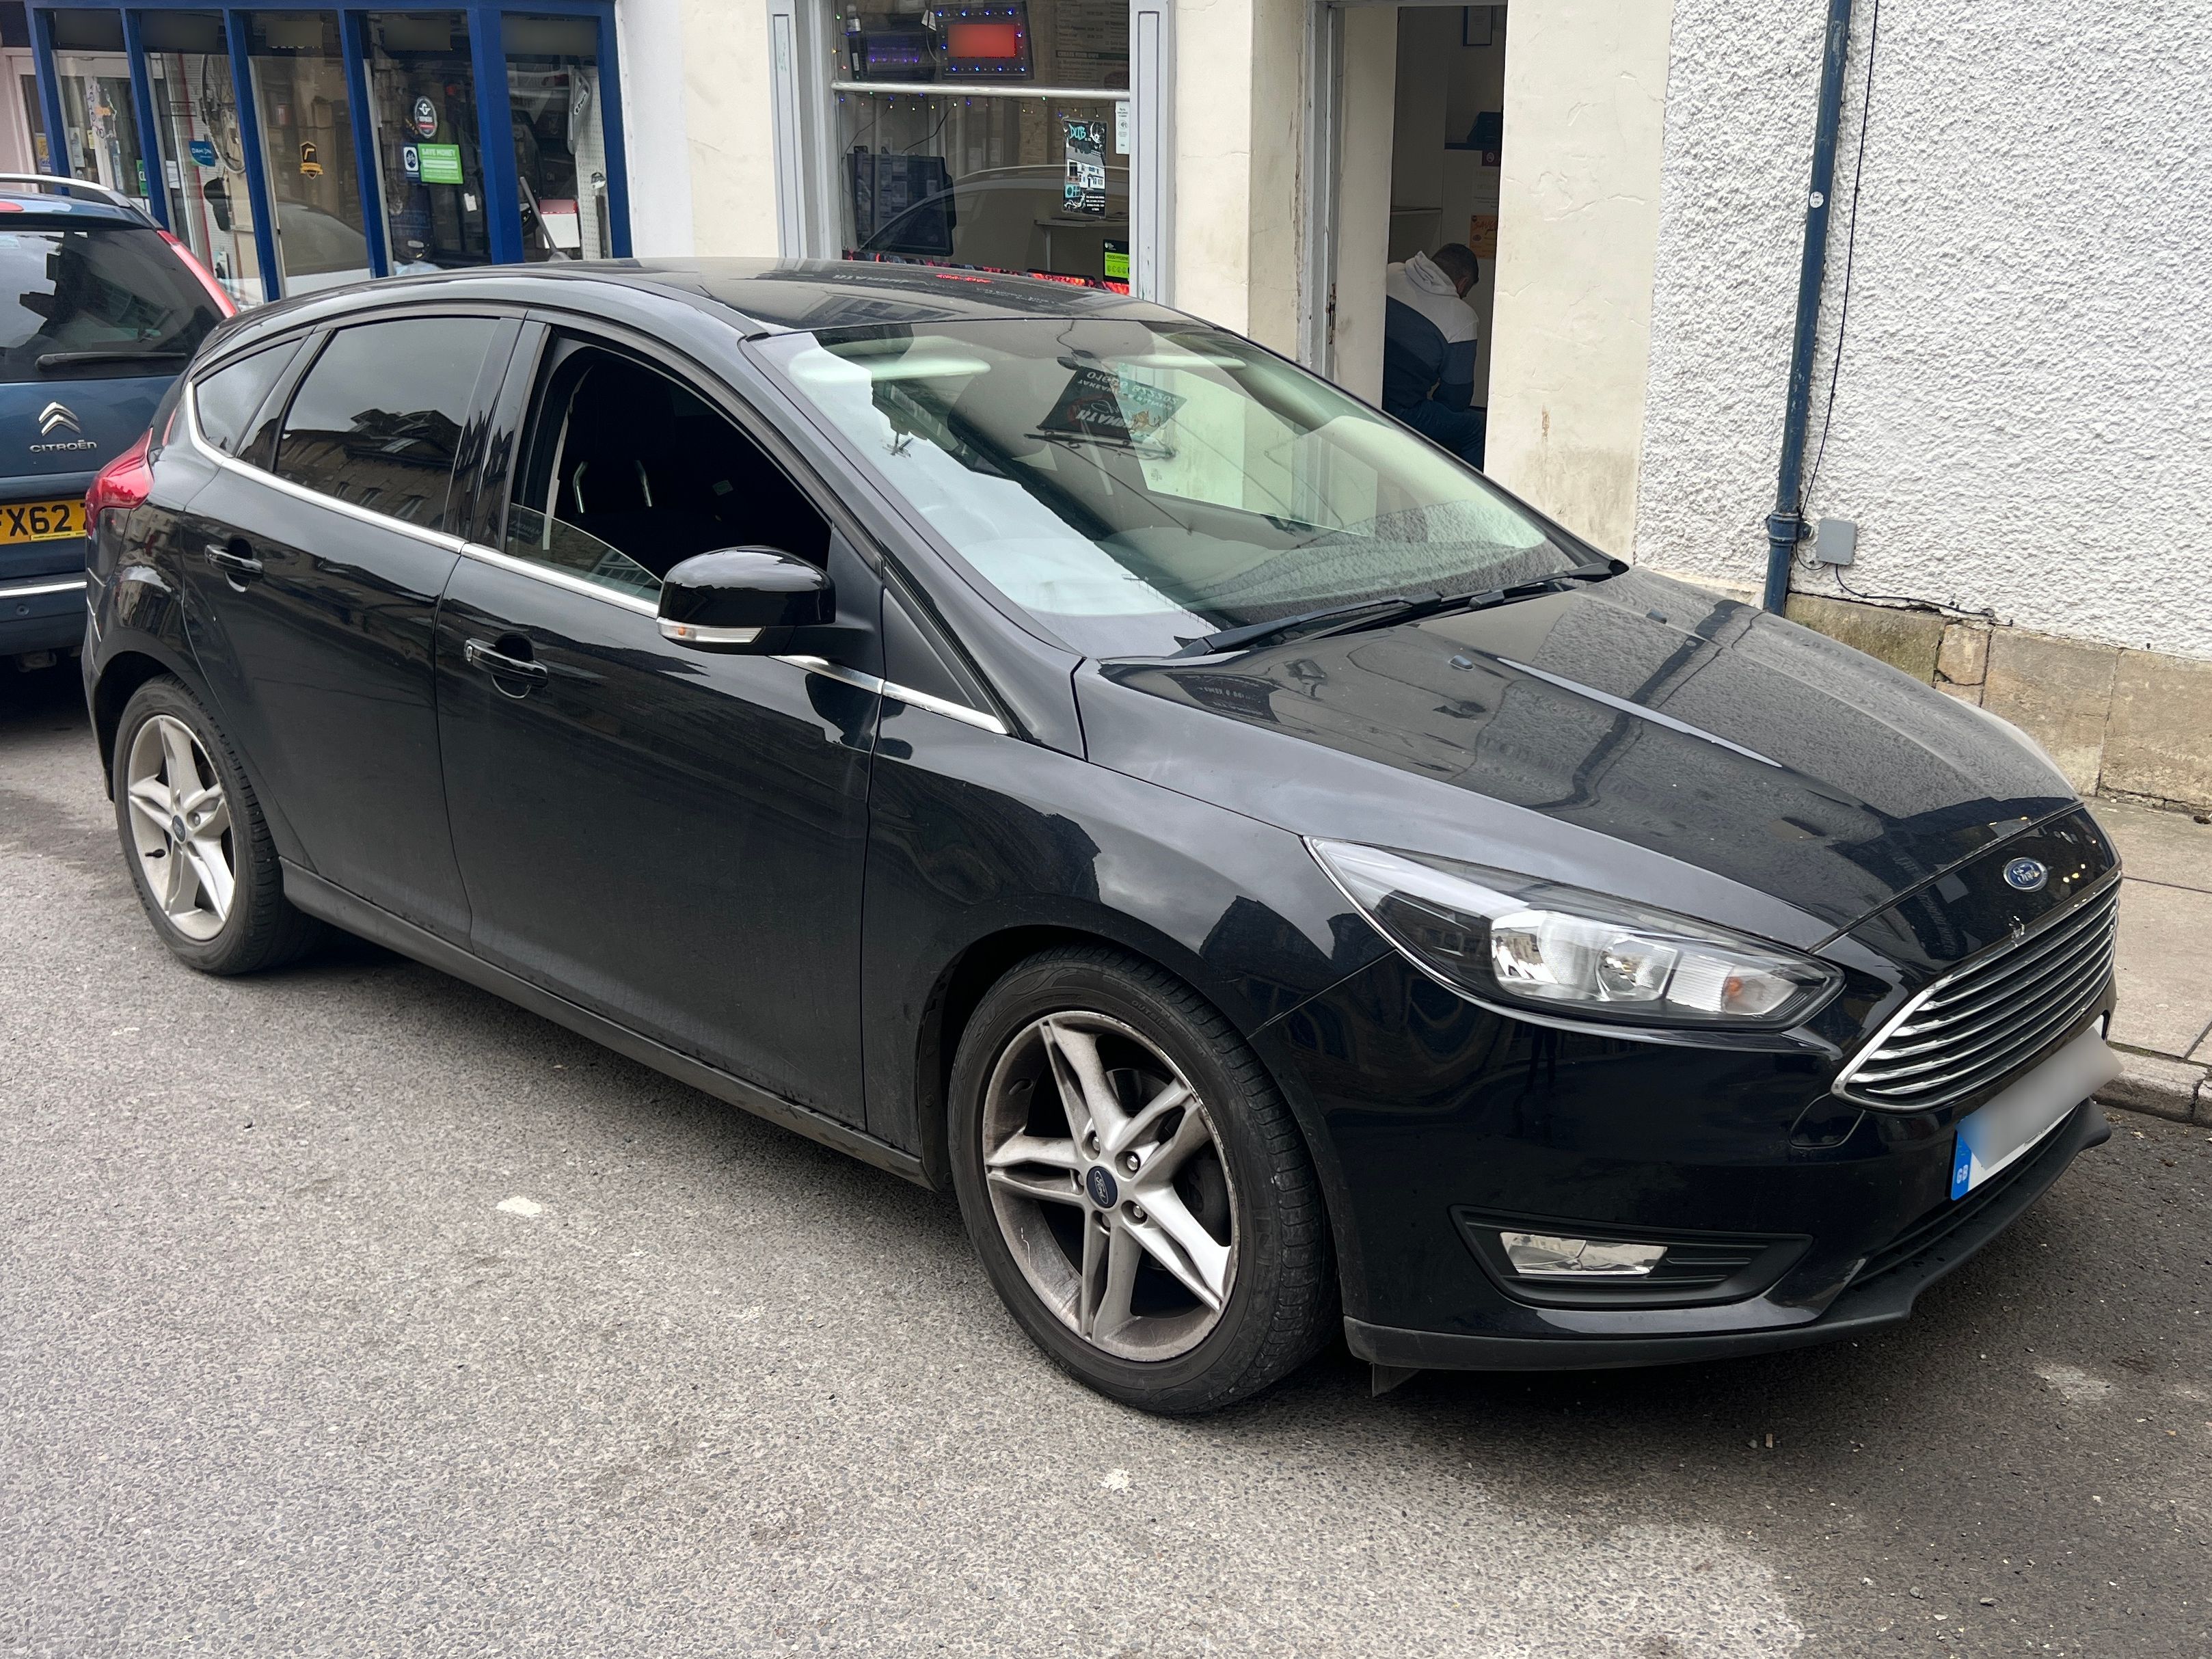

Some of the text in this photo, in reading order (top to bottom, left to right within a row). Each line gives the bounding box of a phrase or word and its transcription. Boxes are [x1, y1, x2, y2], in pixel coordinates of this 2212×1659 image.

[1068, 123, 1087, 141] DUB
[30, 439, 97, 453] CITROËN
[0, 506, 72, 537] X62
